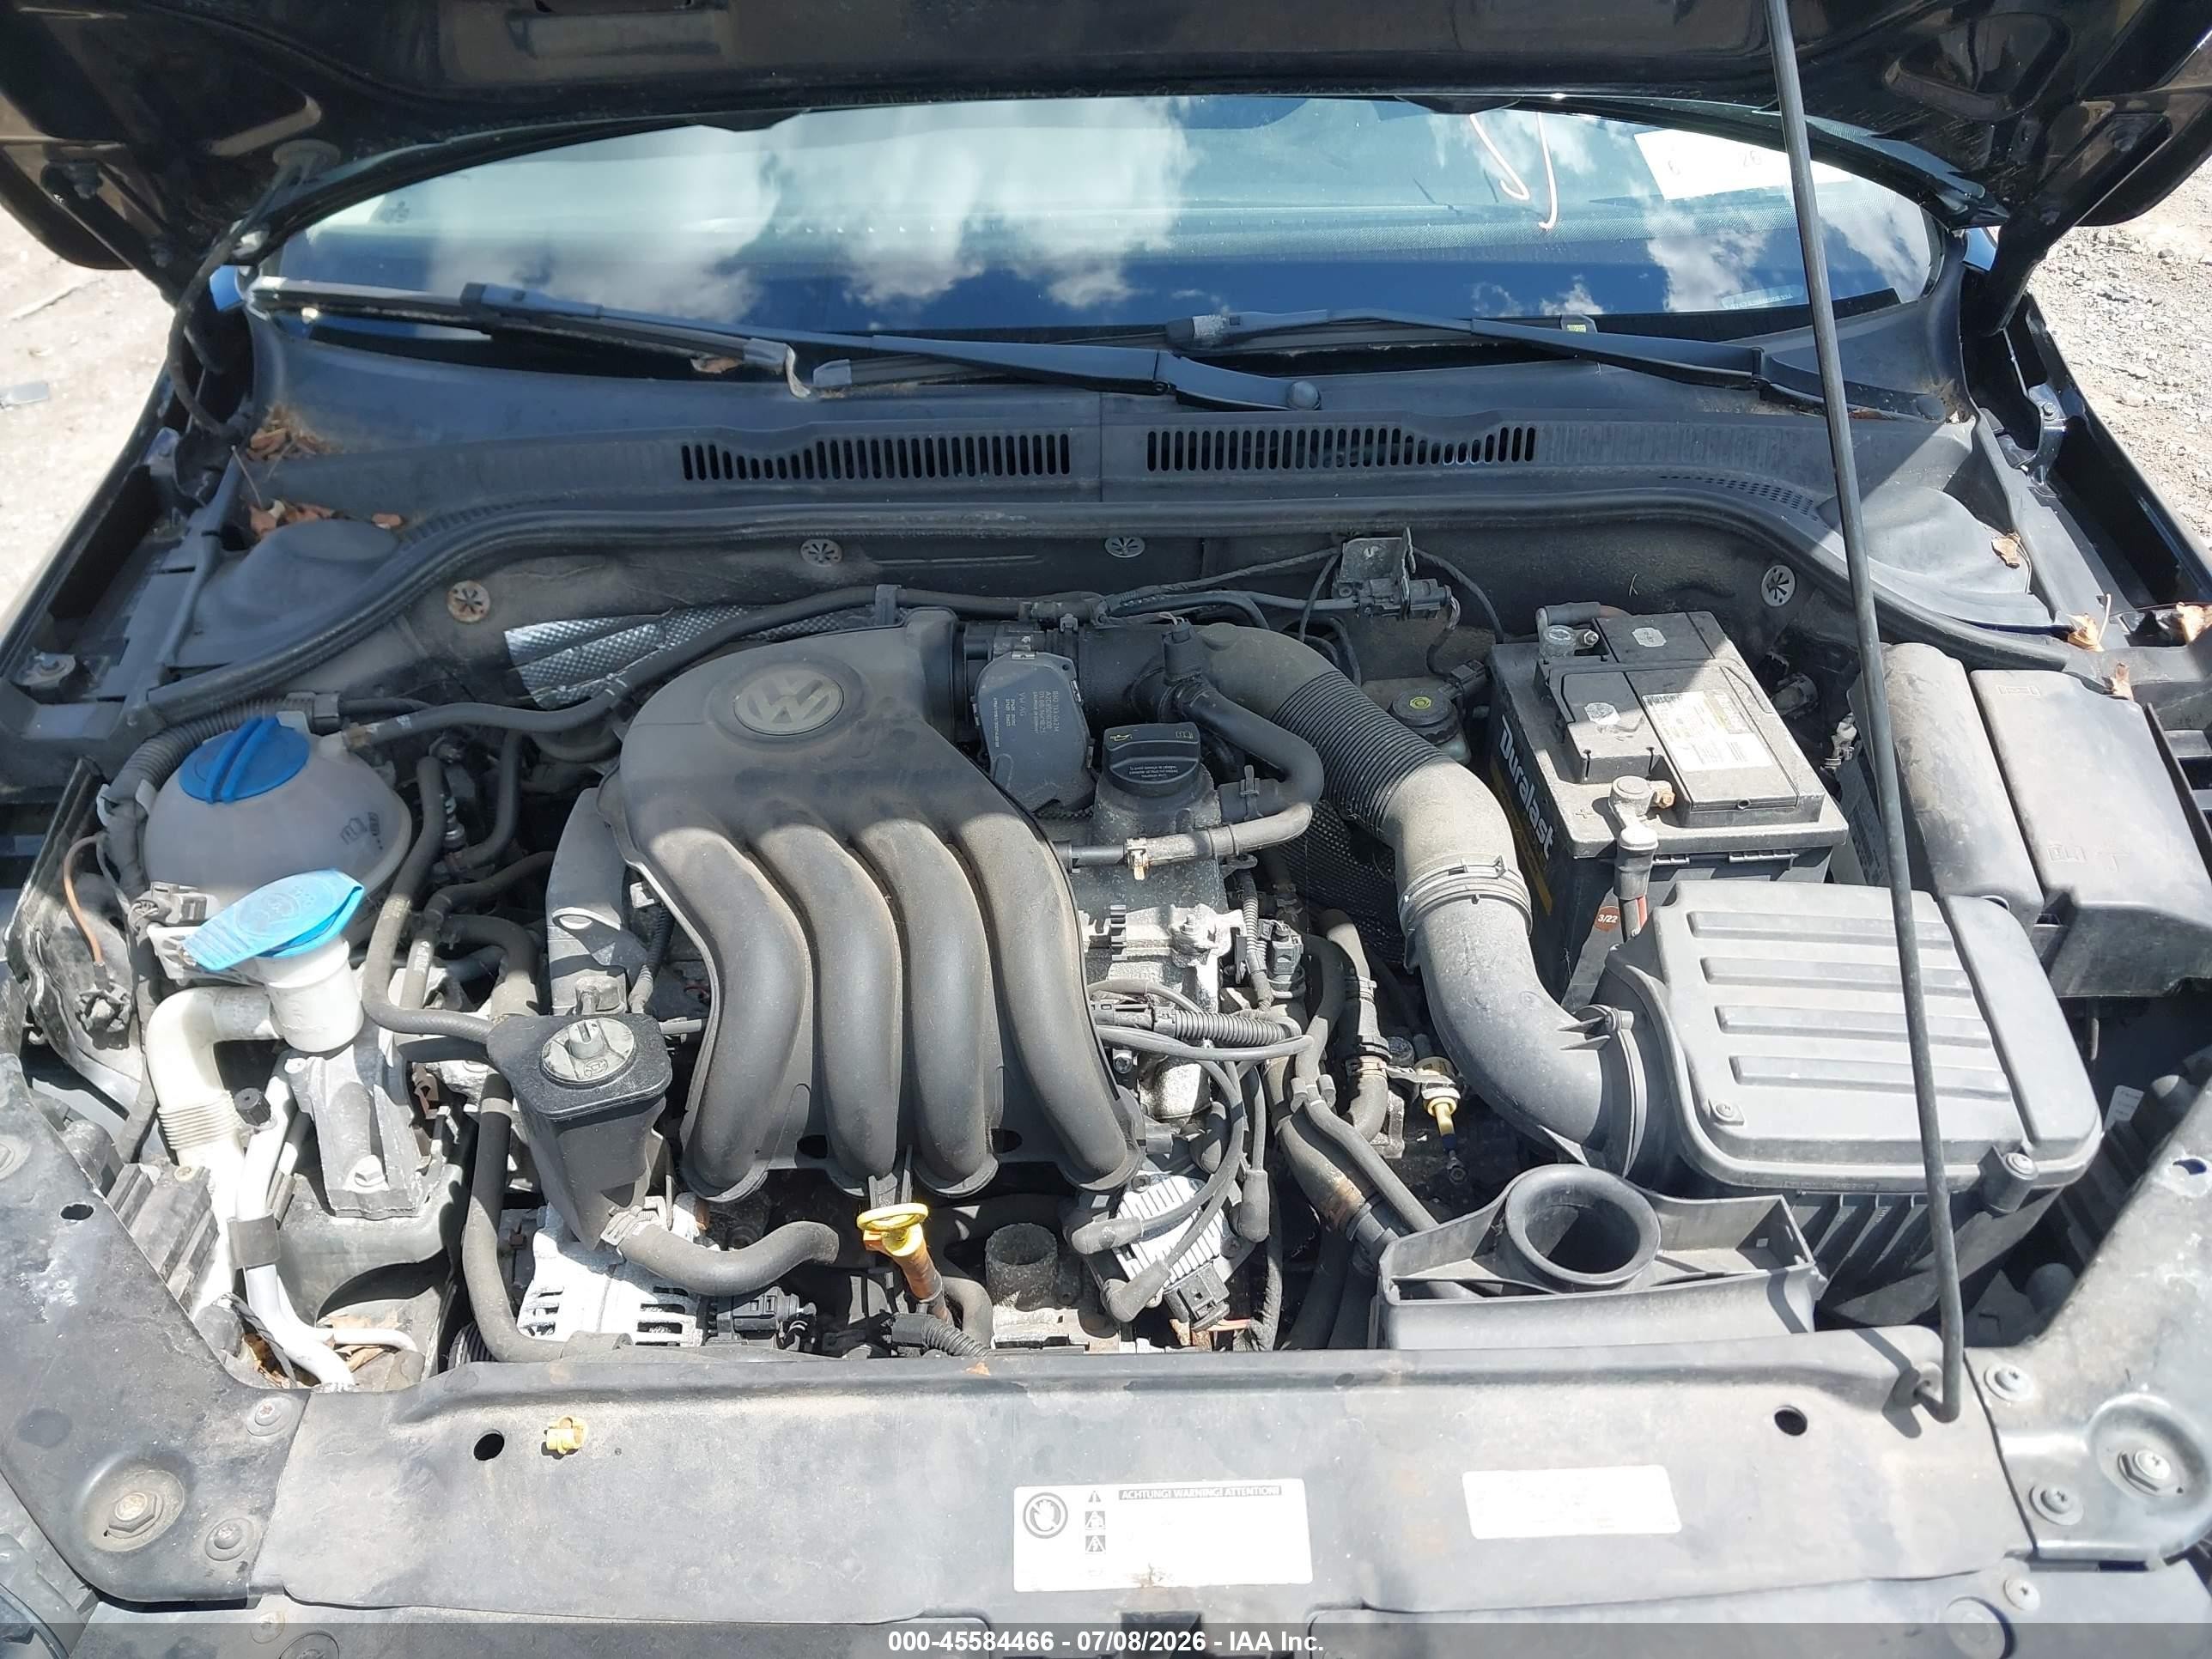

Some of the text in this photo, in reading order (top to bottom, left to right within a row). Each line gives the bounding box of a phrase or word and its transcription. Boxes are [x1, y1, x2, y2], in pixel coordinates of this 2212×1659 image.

[734, 670, 844, 735] VW
[1499, 714, 1555, 860] Duralast
[1597, 914, 1618, 924] 3/22
[1121, 1486, 1279, 1499] ACHTUNG! WARNING! ATTENTION!
